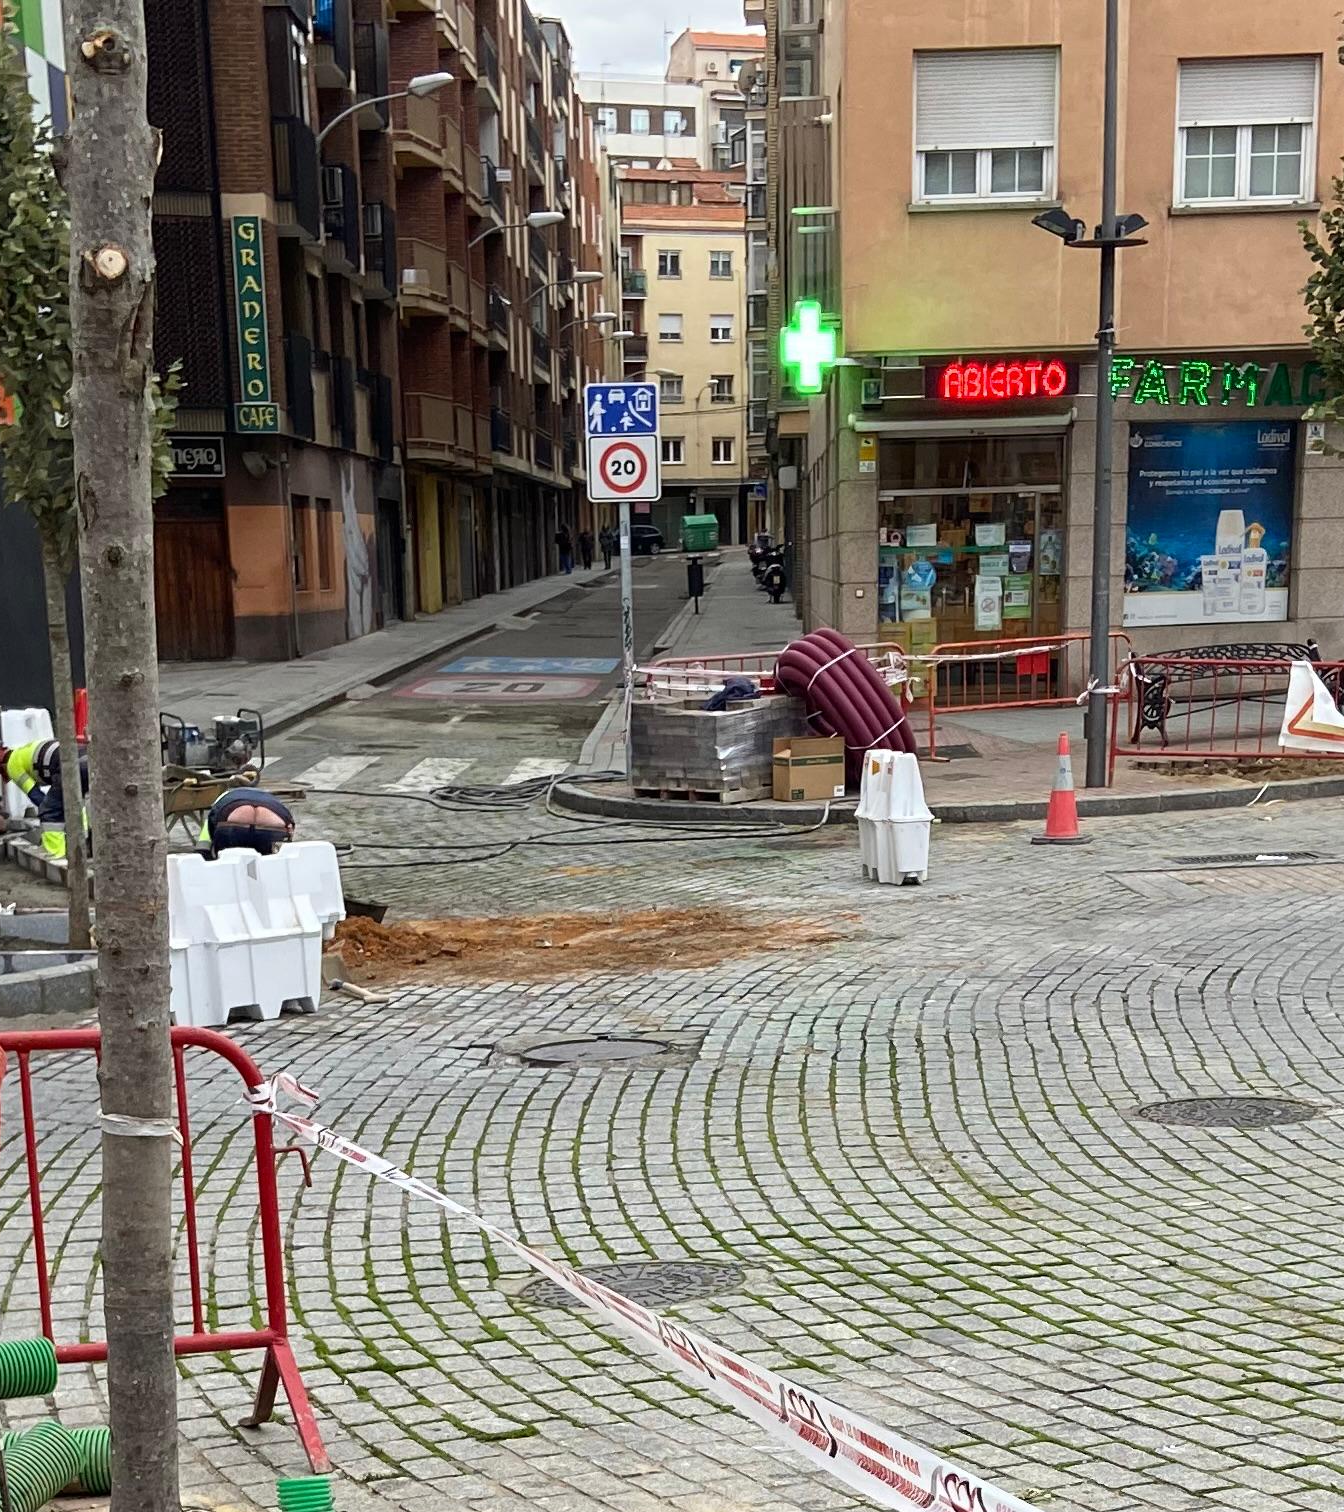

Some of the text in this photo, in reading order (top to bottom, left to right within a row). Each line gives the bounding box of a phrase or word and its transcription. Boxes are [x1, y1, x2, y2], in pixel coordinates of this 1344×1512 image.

[237, 223, 264, 397] GRANERO
[943, 360, 1067, 399] ABIERTO
[1109, 355, 1325, 407] FARMAC
[239, 406, 275, 429] CAFE
[611, 460, 636, 476] 20
[453, 682, 545, 693] 20
